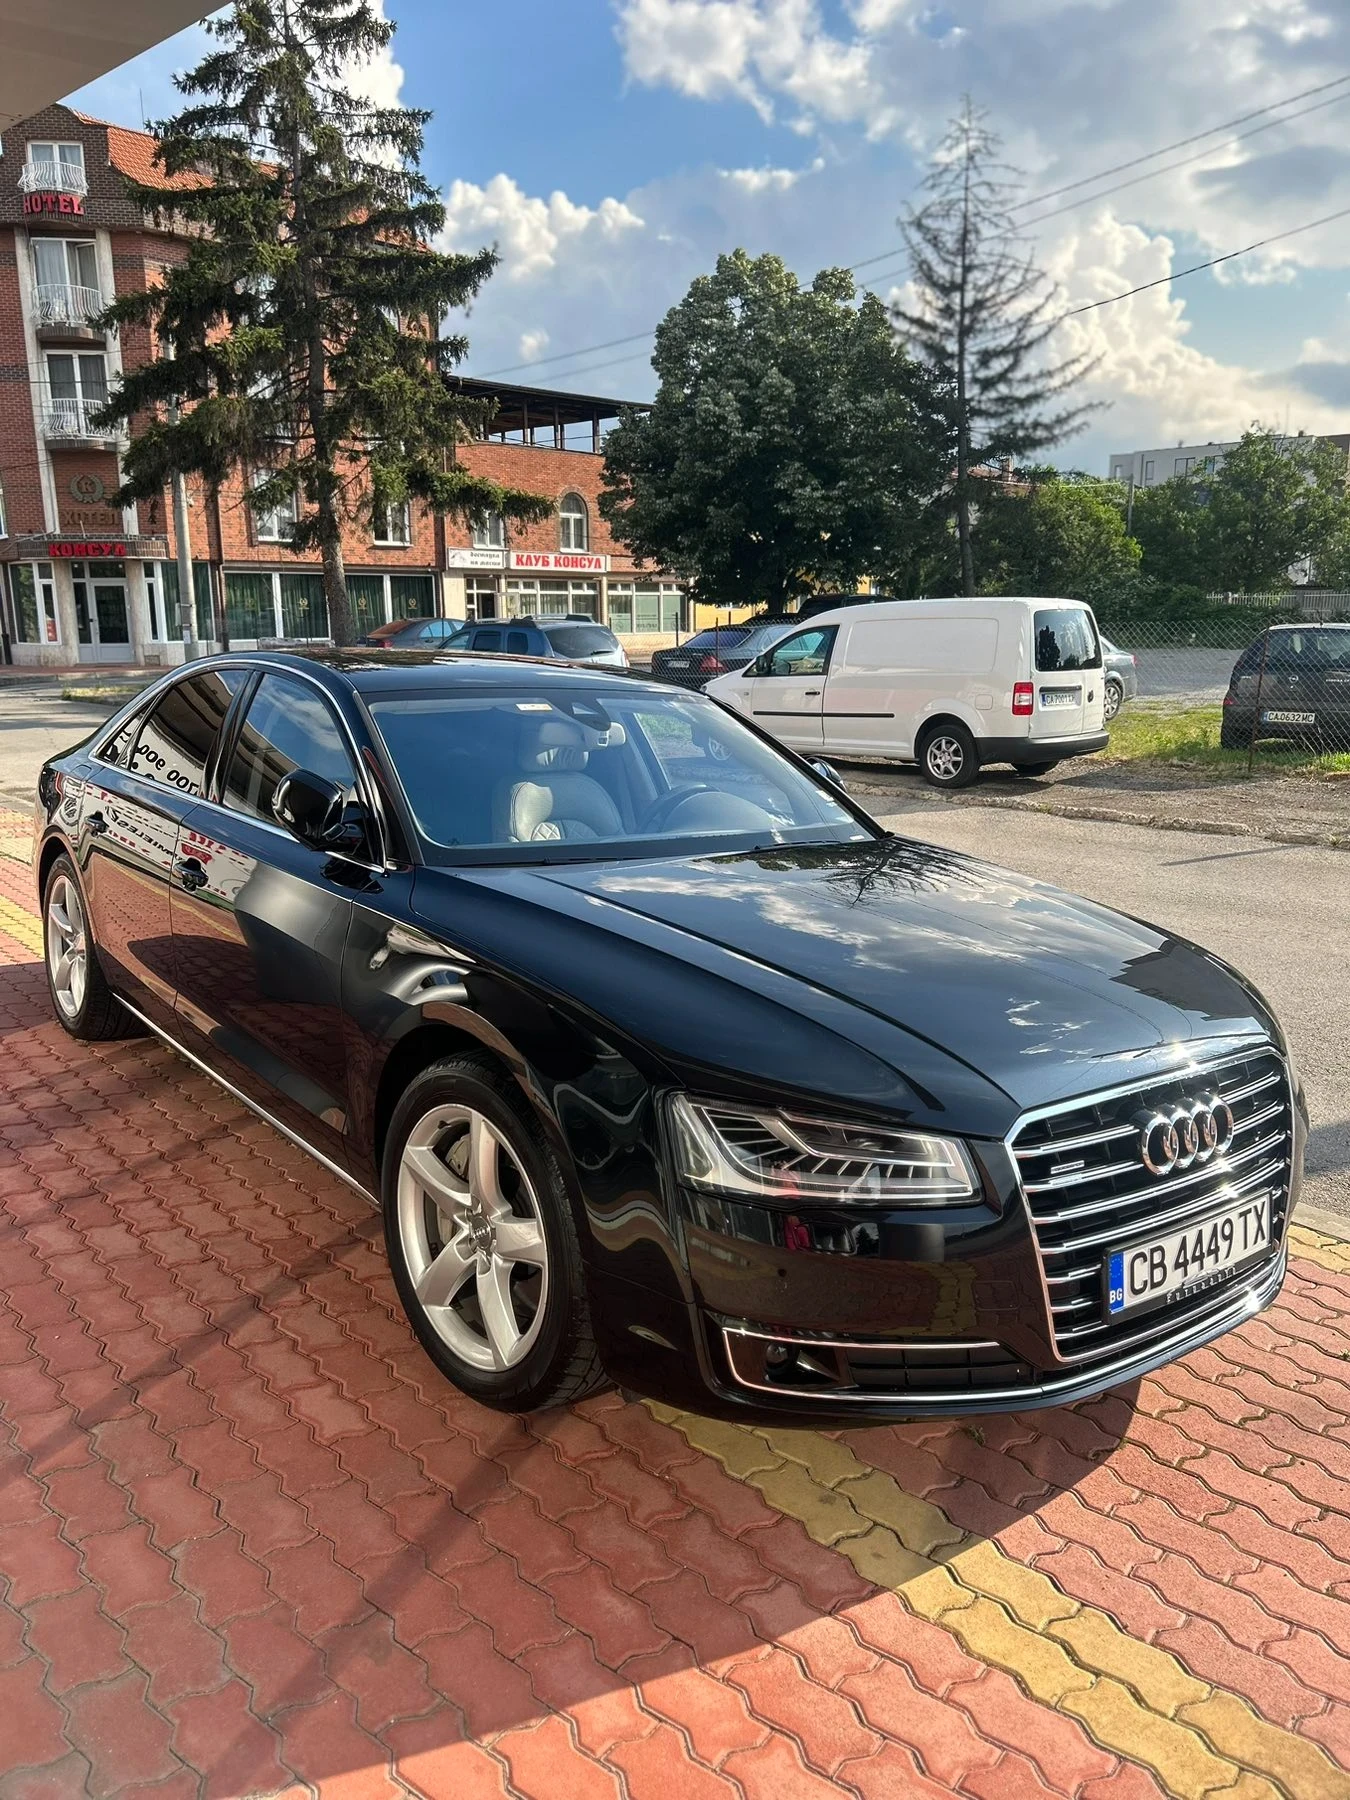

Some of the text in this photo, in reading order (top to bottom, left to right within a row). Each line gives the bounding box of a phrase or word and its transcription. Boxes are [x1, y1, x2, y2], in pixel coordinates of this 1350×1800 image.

[24, 193, 85, 216] HOTEL
[63, 510, 119, 526] ХОТЕЛ
[48, 543, 127, 557] КОНСУЛ
[515, 554, 602, 569] КЛУБ КОНСУЛ
[1130, 1245, 1167, 1296] CB
[1174, 1217, 1234, 1277] 4449
[1238, 1200, 1266, 1250] TX
[1109, 1287, 1123, 1304] BG
